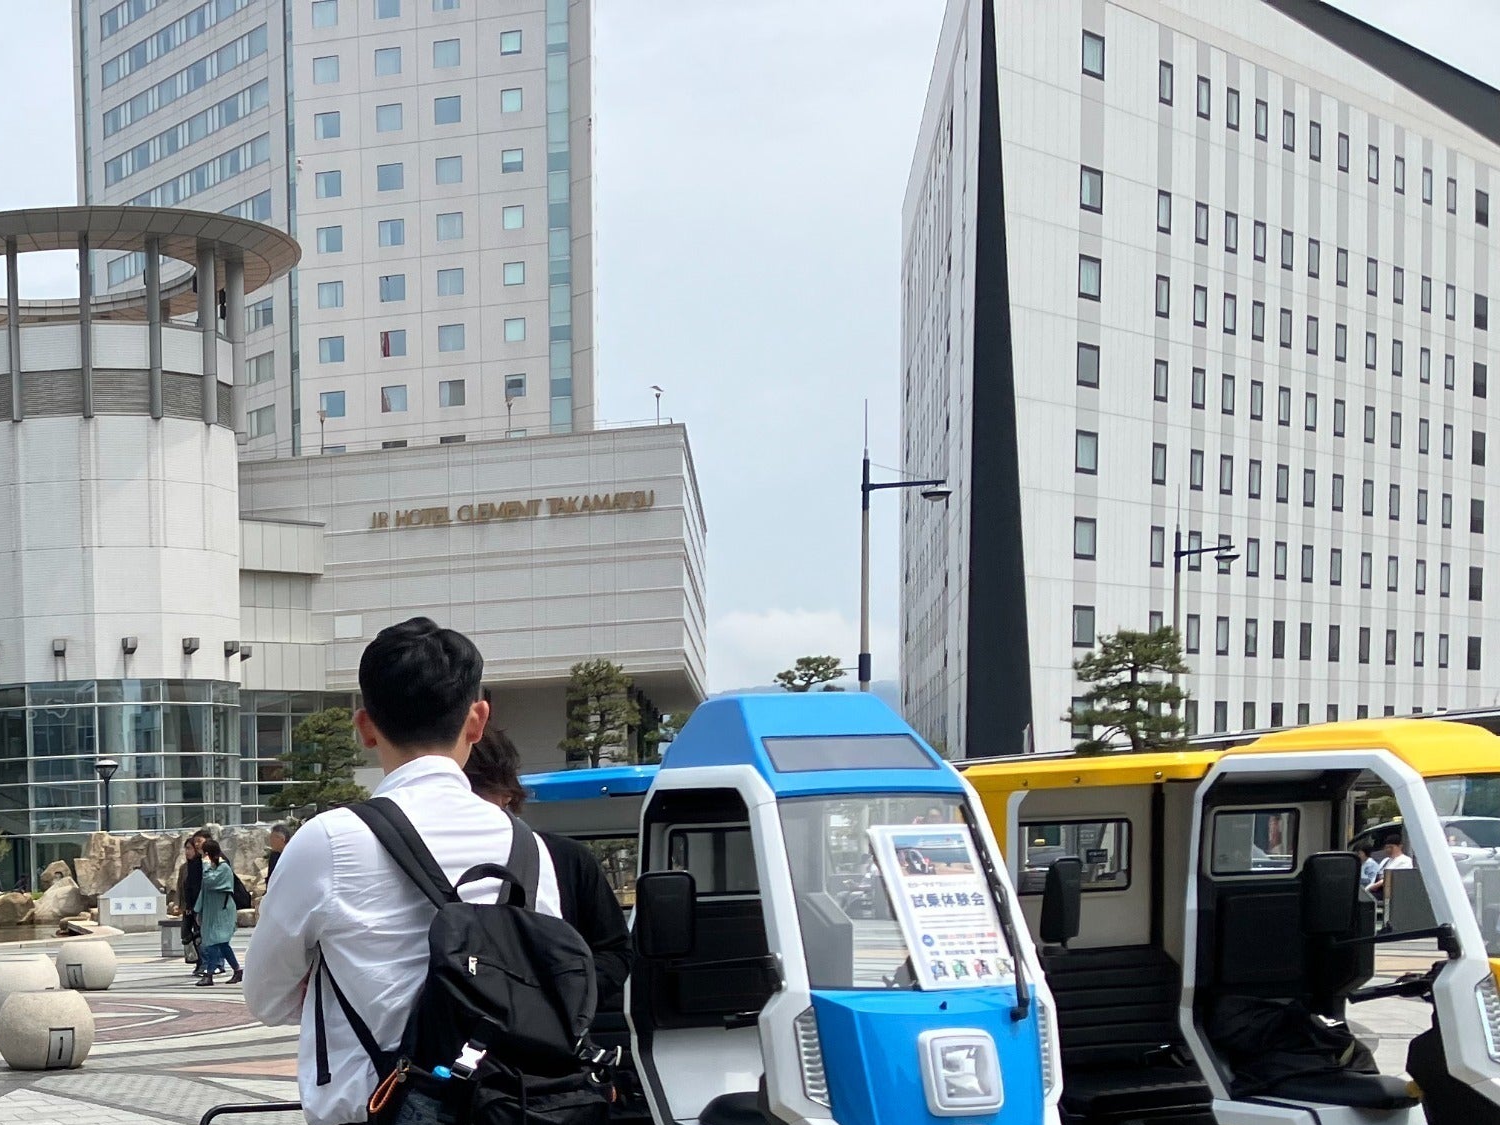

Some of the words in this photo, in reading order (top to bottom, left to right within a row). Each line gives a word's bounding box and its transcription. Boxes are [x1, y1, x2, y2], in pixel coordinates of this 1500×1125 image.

[369, 511, 389, 529] JR
[395, 506, 453, 528] HOTEL
[457, 498, 543, 523] CLEMENT
[545, 489, 655, 516] TAKAMATSU
[910, 891, 986, 909] 試乗体験会
